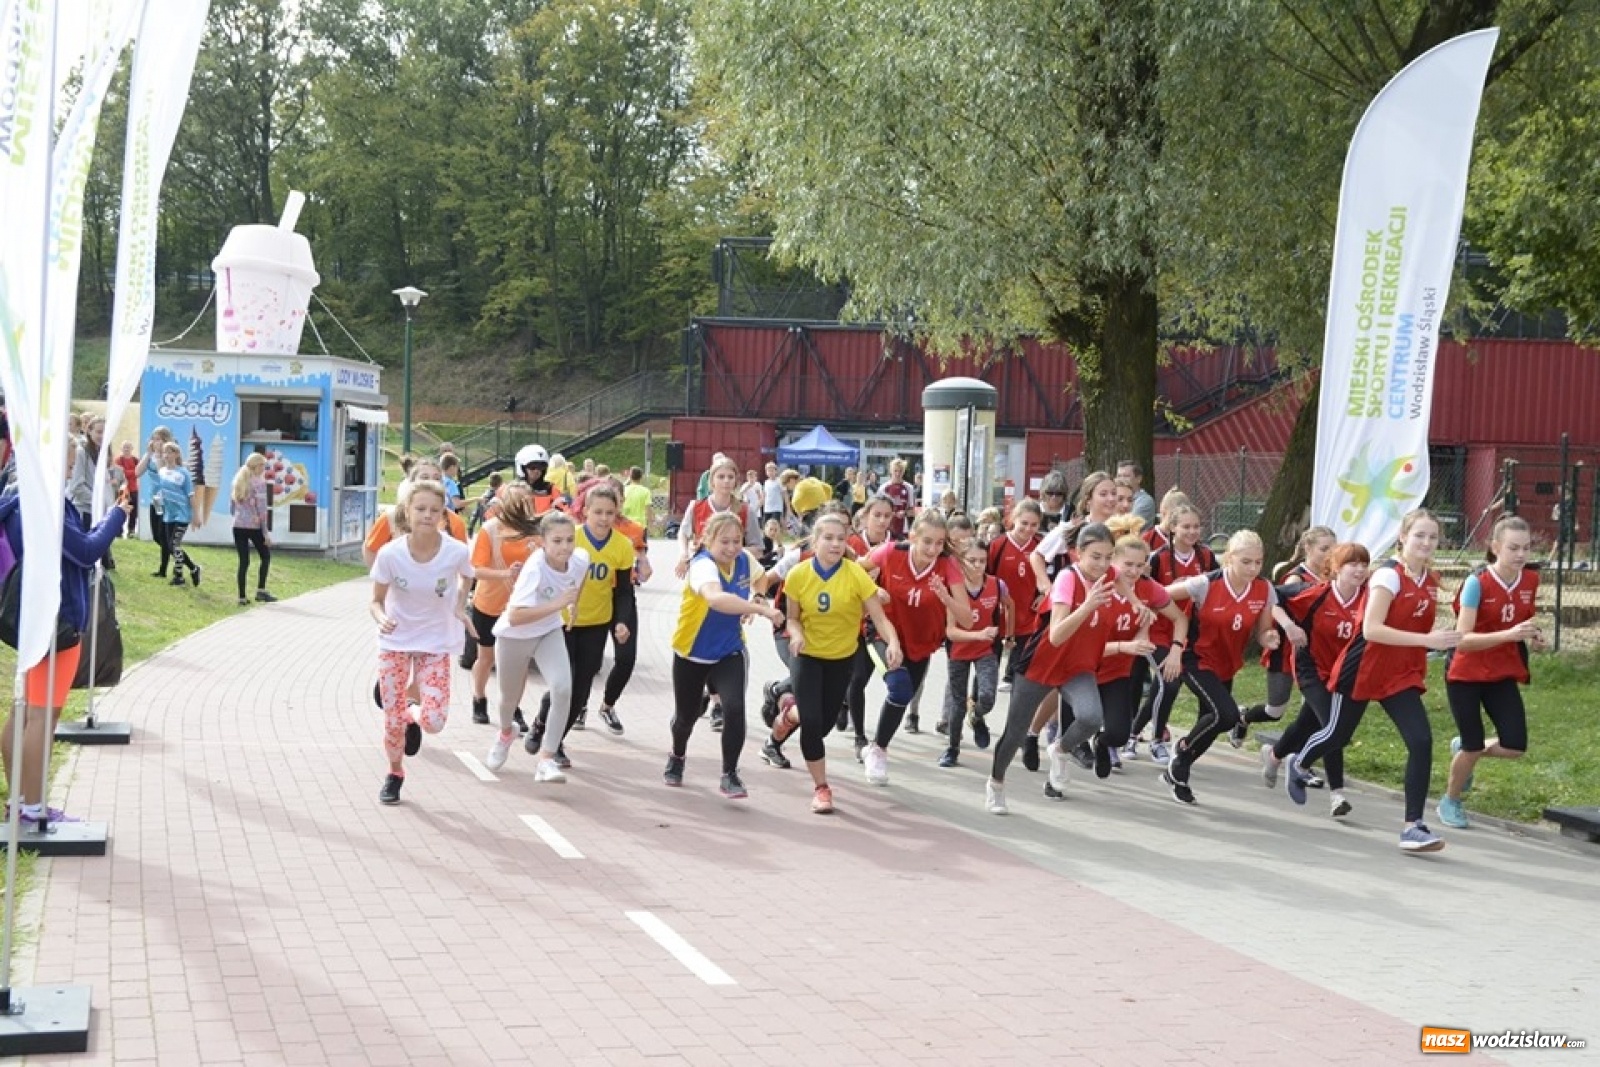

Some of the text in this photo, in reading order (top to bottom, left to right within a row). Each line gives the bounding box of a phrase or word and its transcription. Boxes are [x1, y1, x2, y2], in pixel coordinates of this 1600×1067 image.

[1366, 334, 1391, 417] SPORTU
[1379, 206, 1407, 315] REKREACJI
[1347, 229, 1384, 416] MIEJSKI OŚRODEK
[1410, 287, 1437, 419] Wodzisław Śląski
[1388, 313, 1414, 419] CENTRUM
[158, 391, 231, 424] Lody
[588, 562, 608, 580] 10
[817, 592, 830, 611] 9
[907, 588, 921, 607] 11
[1116, 613, 1131, 631] 12
[1501, 603, 1515, 622] 13
[1231, 614, 1242, 631] 8
[1336, 621, 1353, 639] 13
